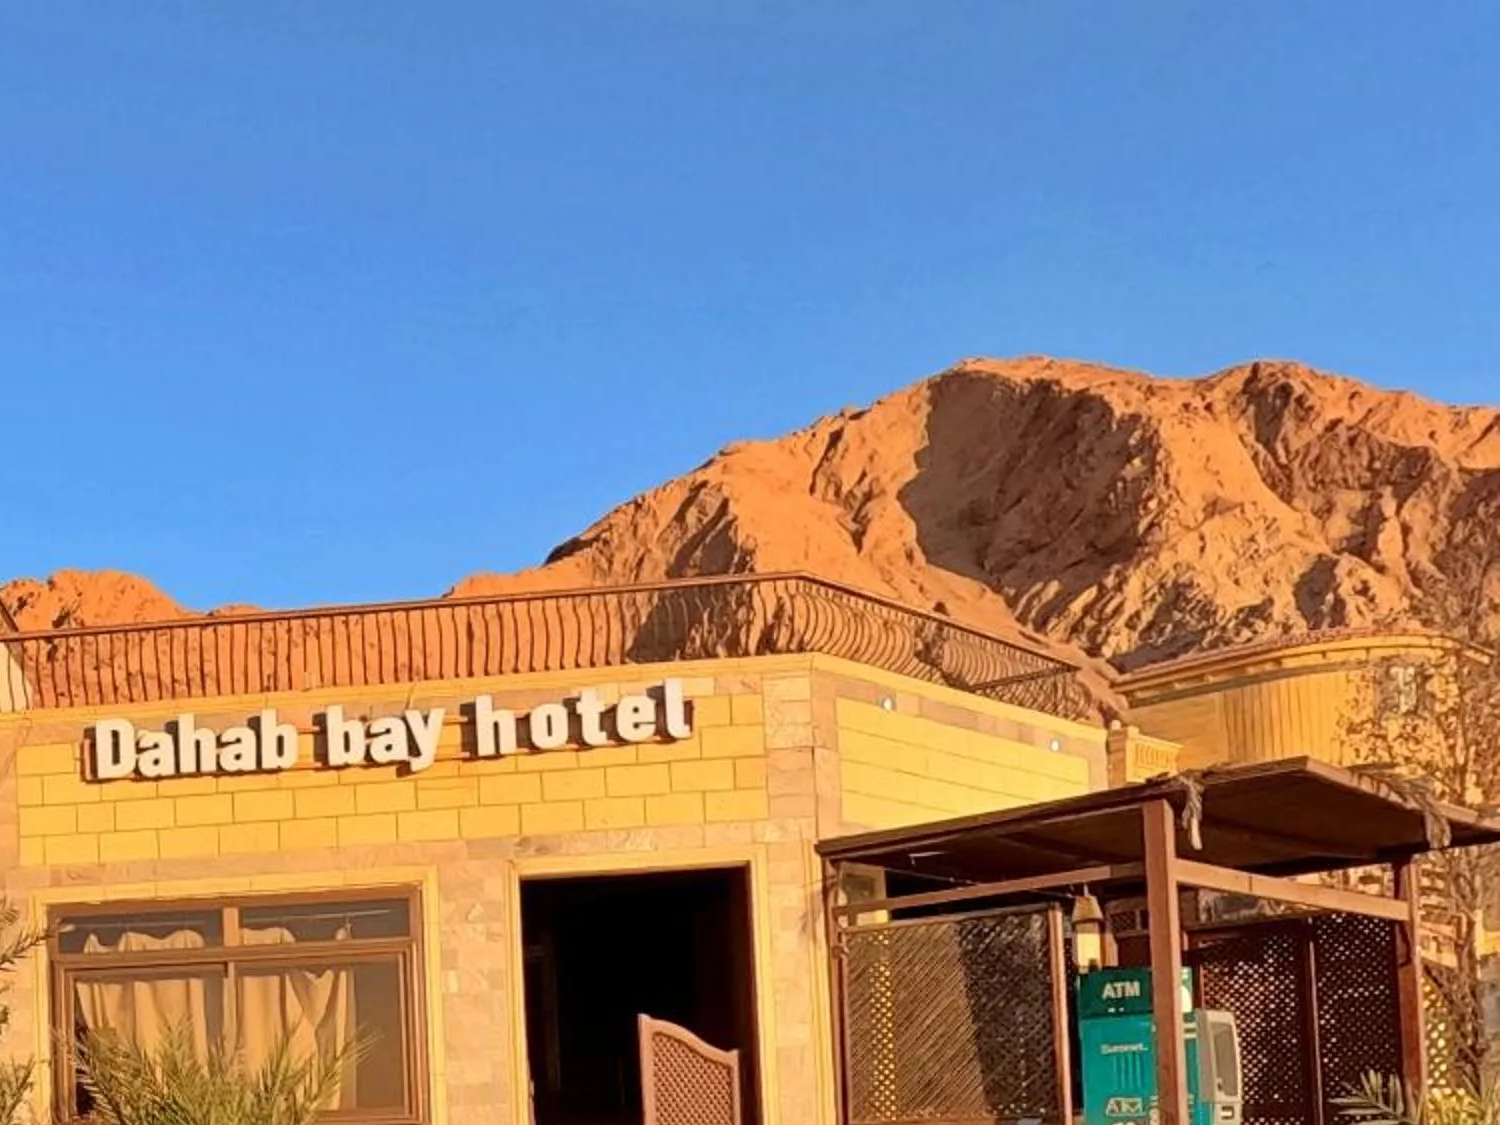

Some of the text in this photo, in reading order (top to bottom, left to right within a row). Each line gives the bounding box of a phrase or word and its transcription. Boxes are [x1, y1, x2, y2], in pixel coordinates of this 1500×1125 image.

[88, 678, 693, 780] Dahab bay hotel
[1101, 981, 1141, 1000] ATM
